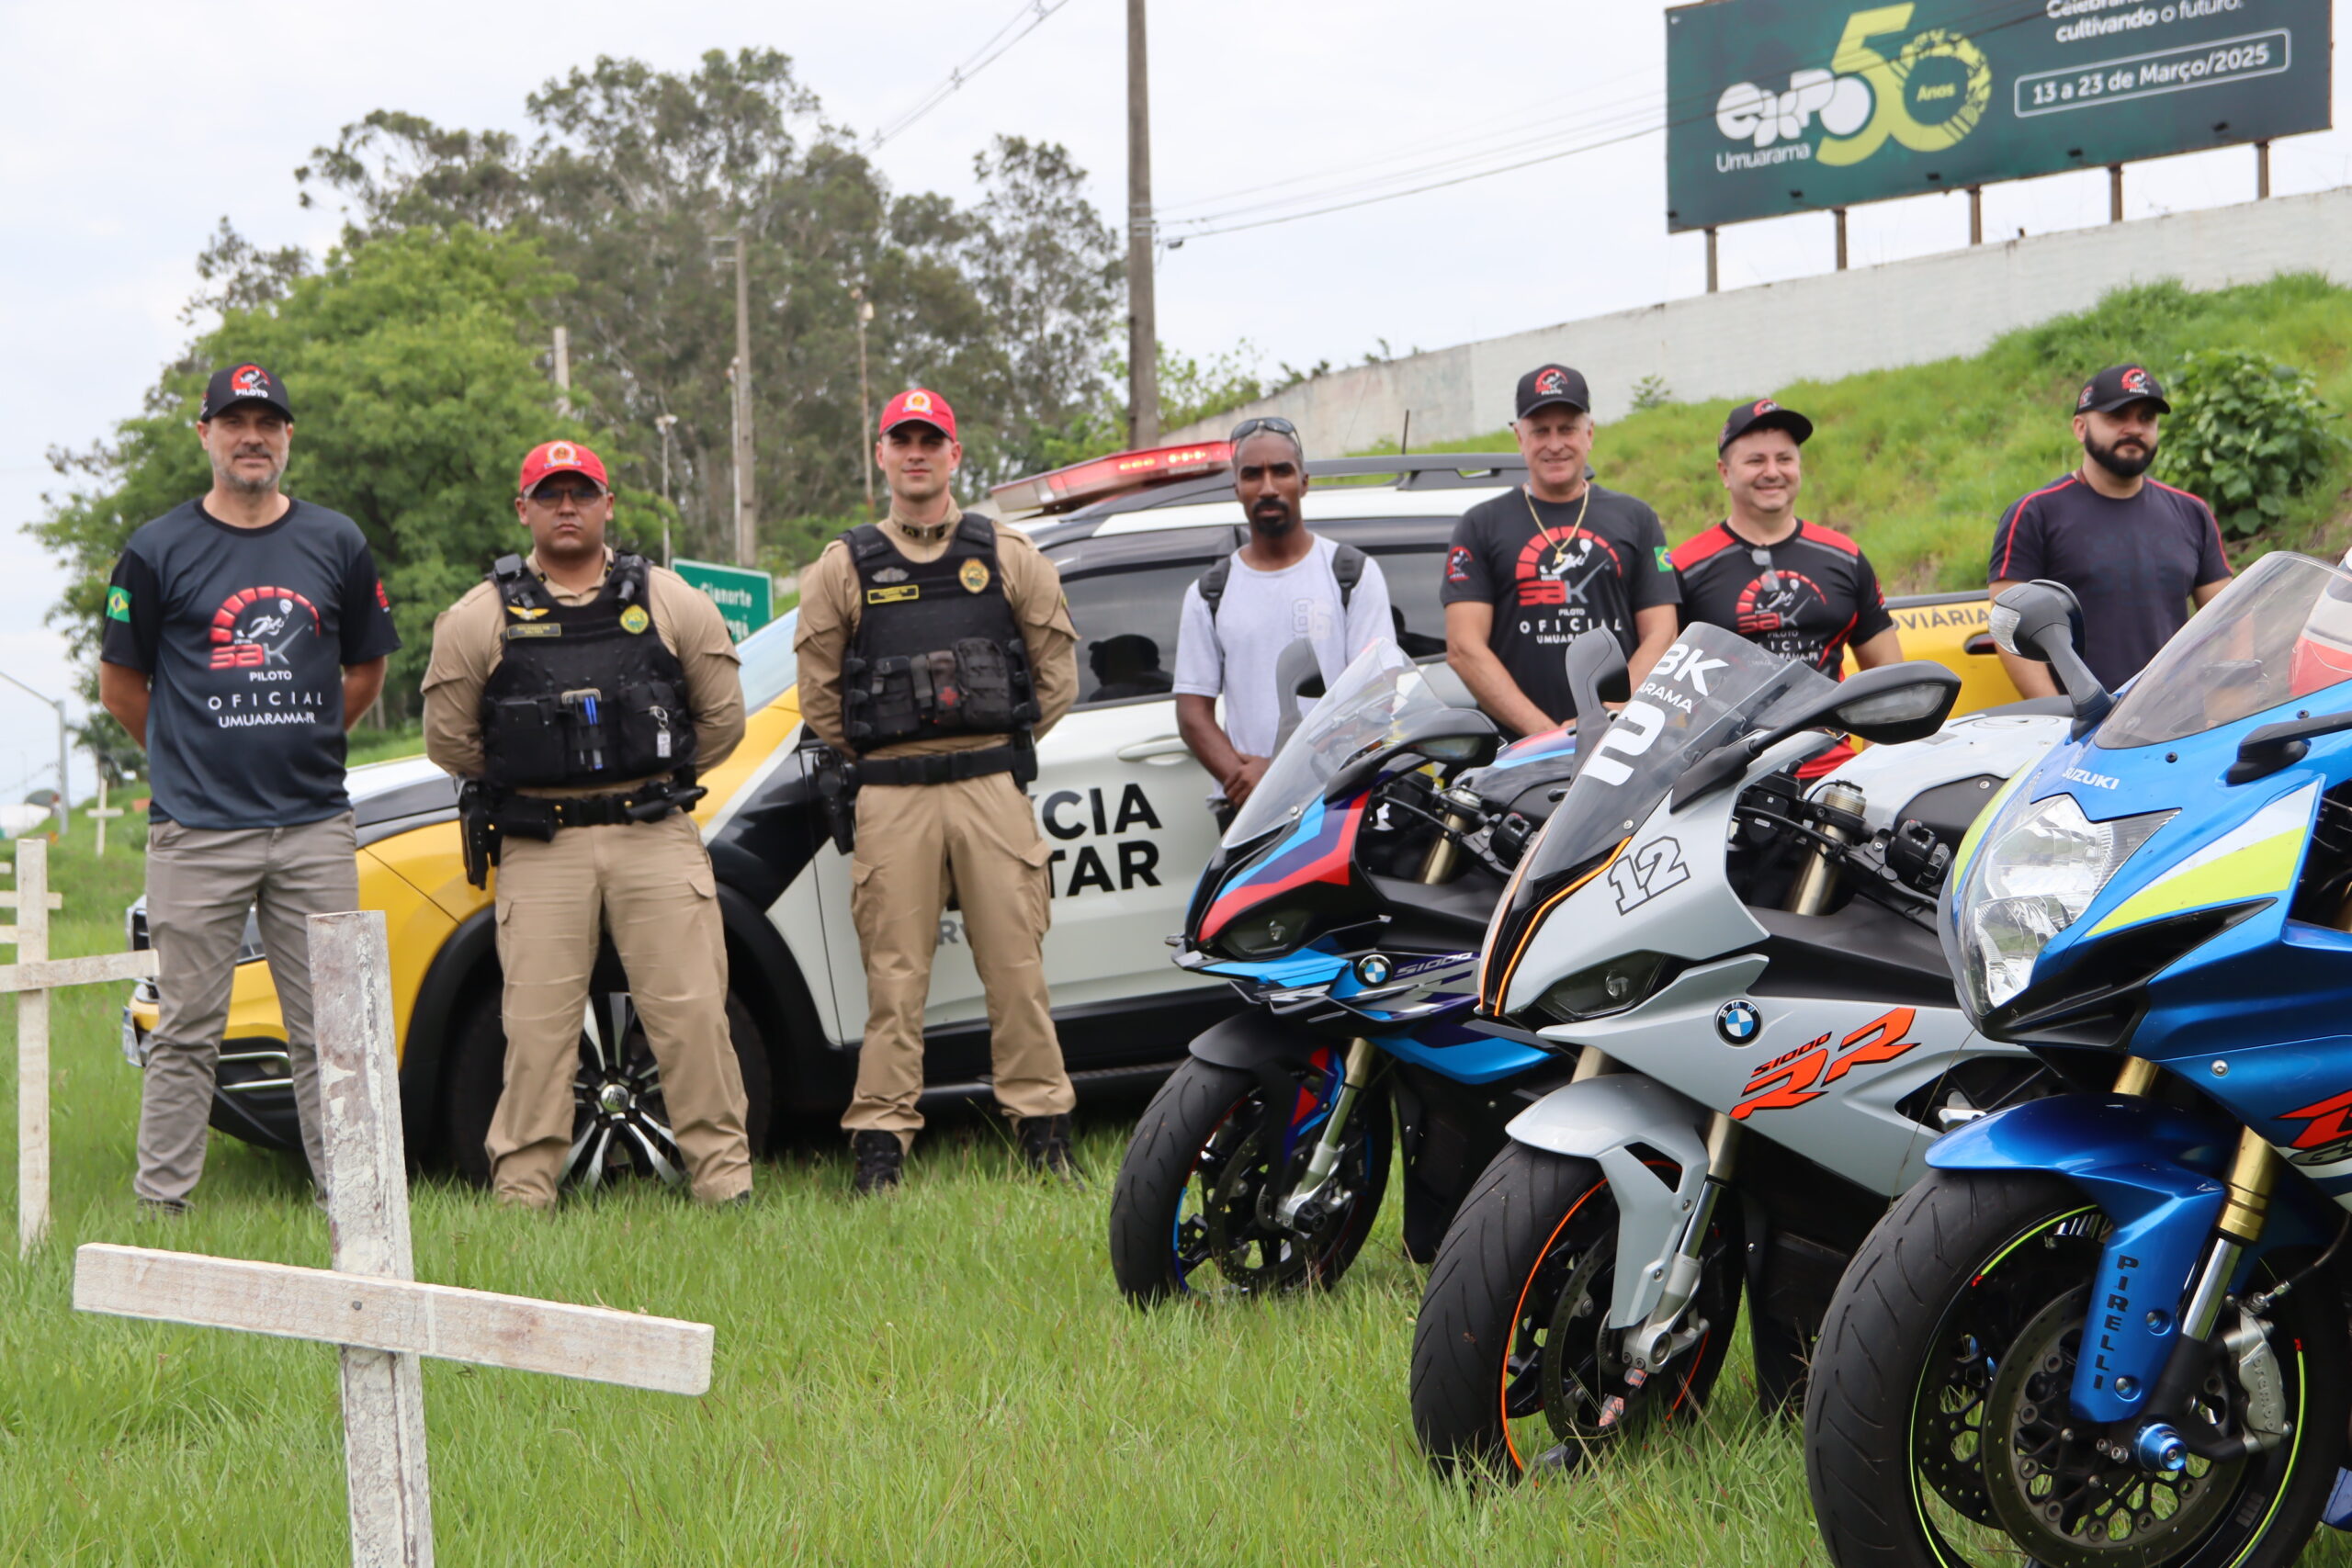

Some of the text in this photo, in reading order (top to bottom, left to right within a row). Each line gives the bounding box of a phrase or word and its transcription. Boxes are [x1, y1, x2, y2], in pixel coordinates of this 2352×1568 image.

[2056, 6, 2158, 42] cultivando
[2160, 5, 2177, 23] o
[1815, 2, 1991, 165] 50
[2033, 42, 2270, 105] 13 a 23 de Março/2025
[1917, 83, 1956, 102] Anos
[1716, 142, 1811, 173] Umuarama
[234, 389, 268, 398] PILOTO
[1558, 608, 1585, 616] PILOTO
[209, 628, 301, 670] SBK
[249, 671, 292, 682] PILOTO
[1648, 642, 1729, 696] BK
[208, 691, 322, 710] OFICIAL
[2062, 766, 2120, 790] SUZUKI
[1608, 836, 1690, 916] 12
[1393, 952, 1474, 978] S1000
[1720, 1001, 1755, 1018] BMW
[1728, 1007, 1922, 1121] RR
[1750, 1031, 1833, 1077] S1000
[2094, 1255, 2139, 1390] PIRELLI
[2253, 1352, 2278, 1432] brembo
